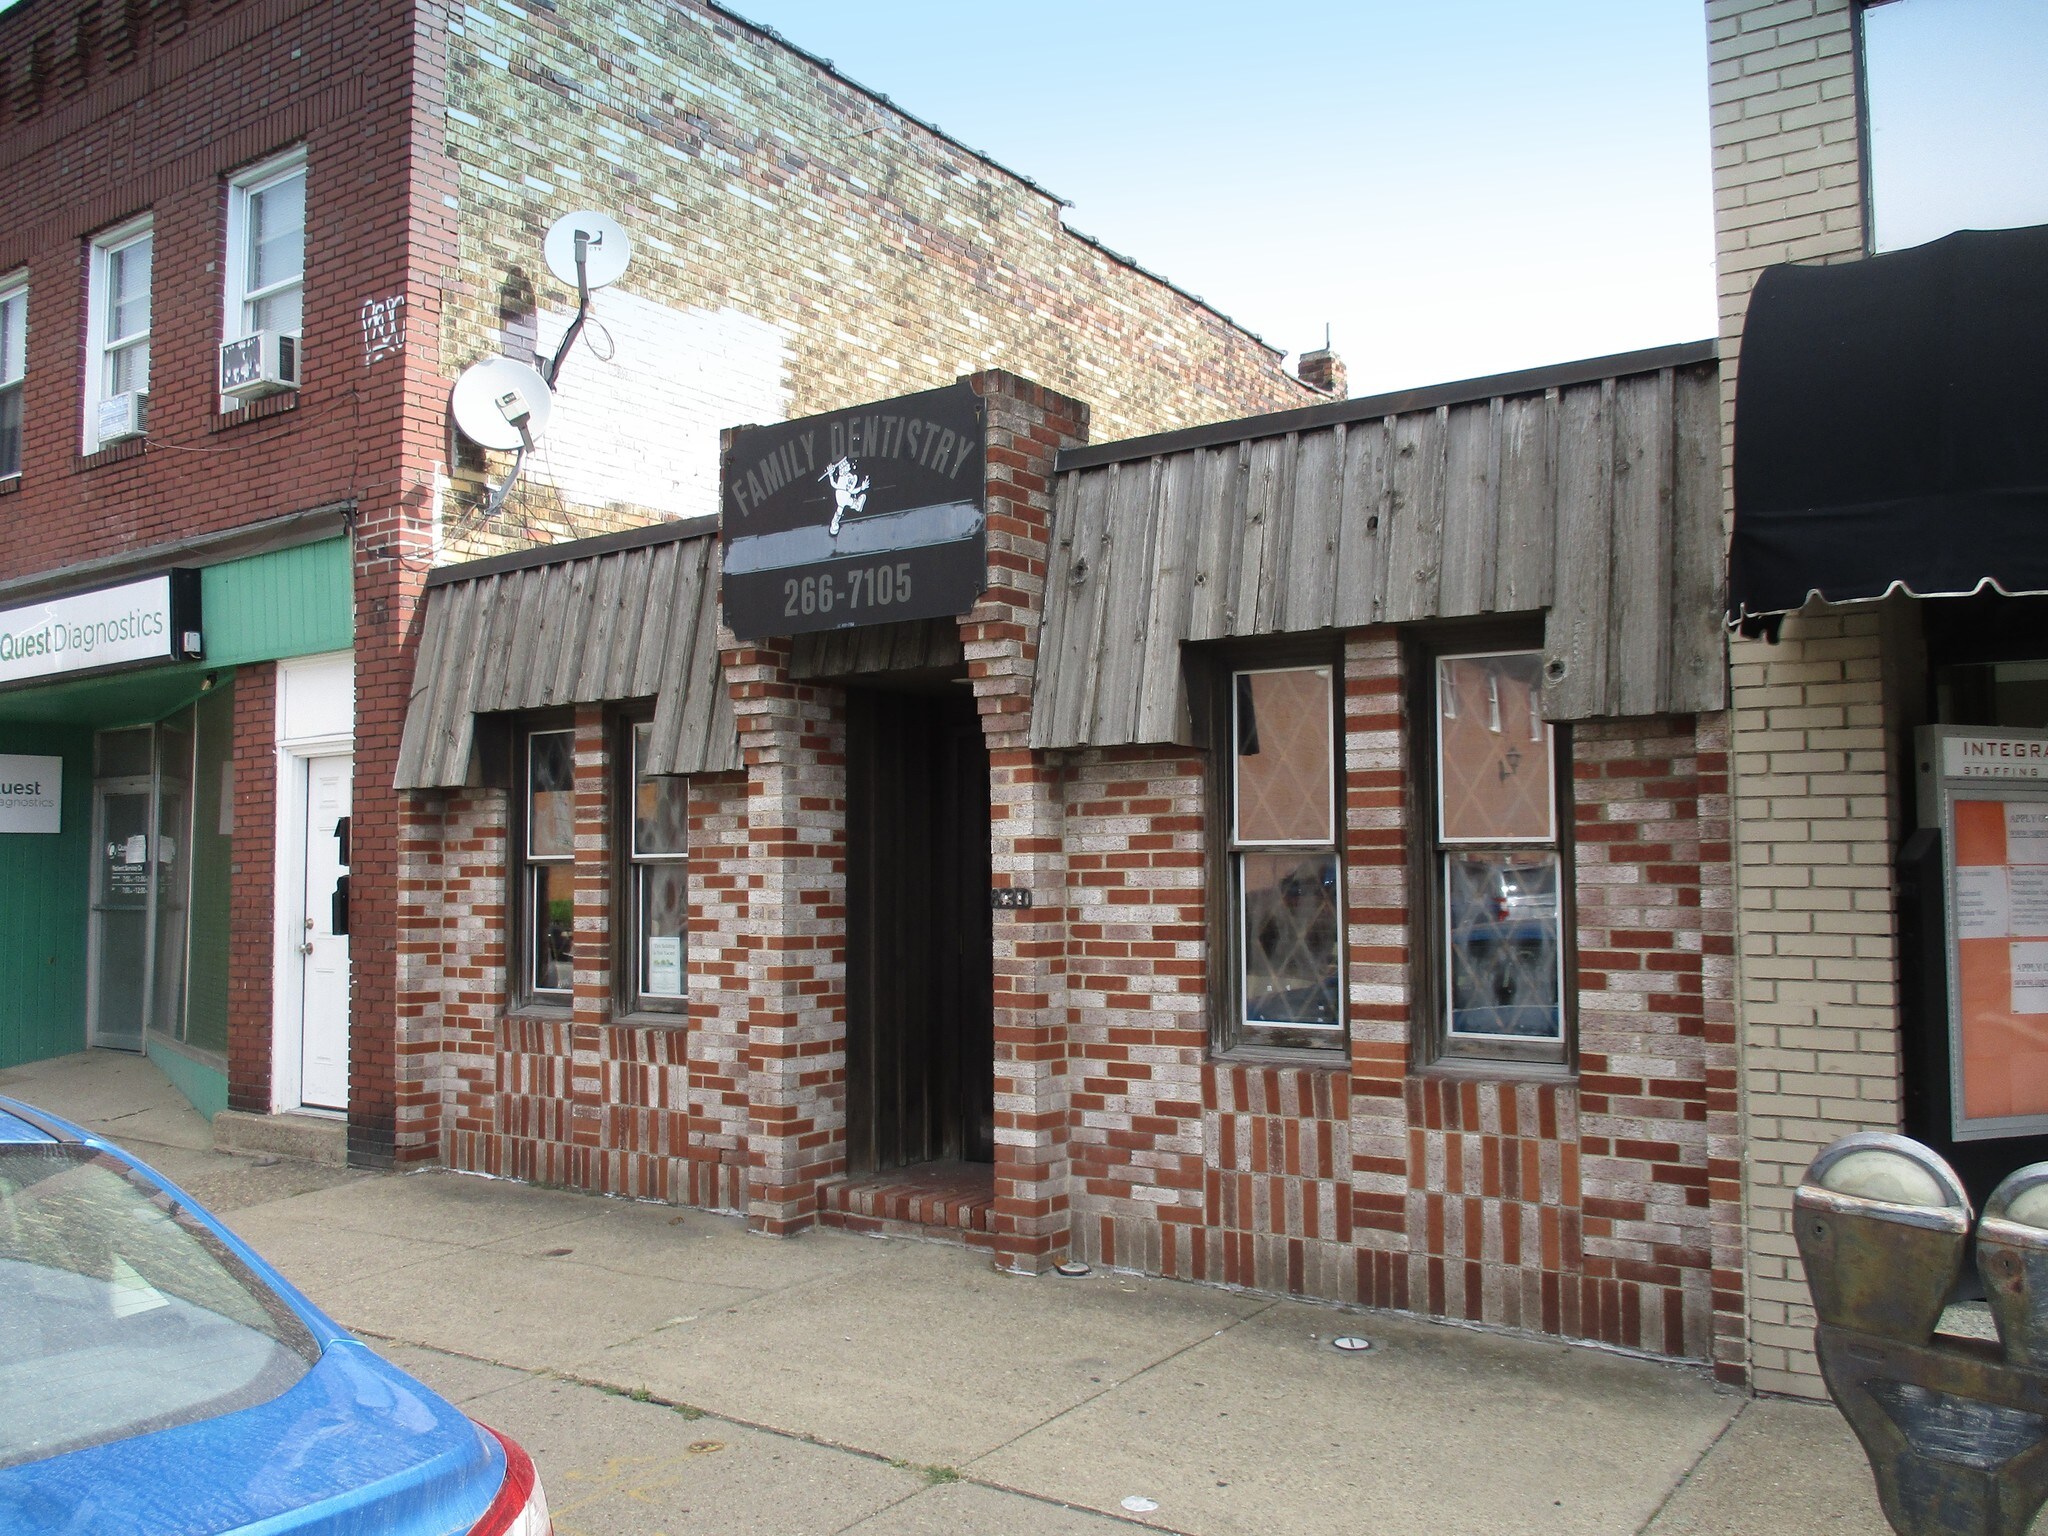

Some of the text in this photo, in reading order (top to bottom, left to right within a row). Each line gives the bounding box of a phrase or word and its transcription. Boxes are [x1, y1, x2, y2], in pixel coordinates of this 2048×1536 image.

[731, 415, 976, 518] FAMILY DENTISTRY
[784, 563, 912, 618] 266-7105
[0, 609, 163, 662] Quest Diagnostics
[0, 781, 42, 796] uest
[1963, 766, 2039, 777] STAFFING
